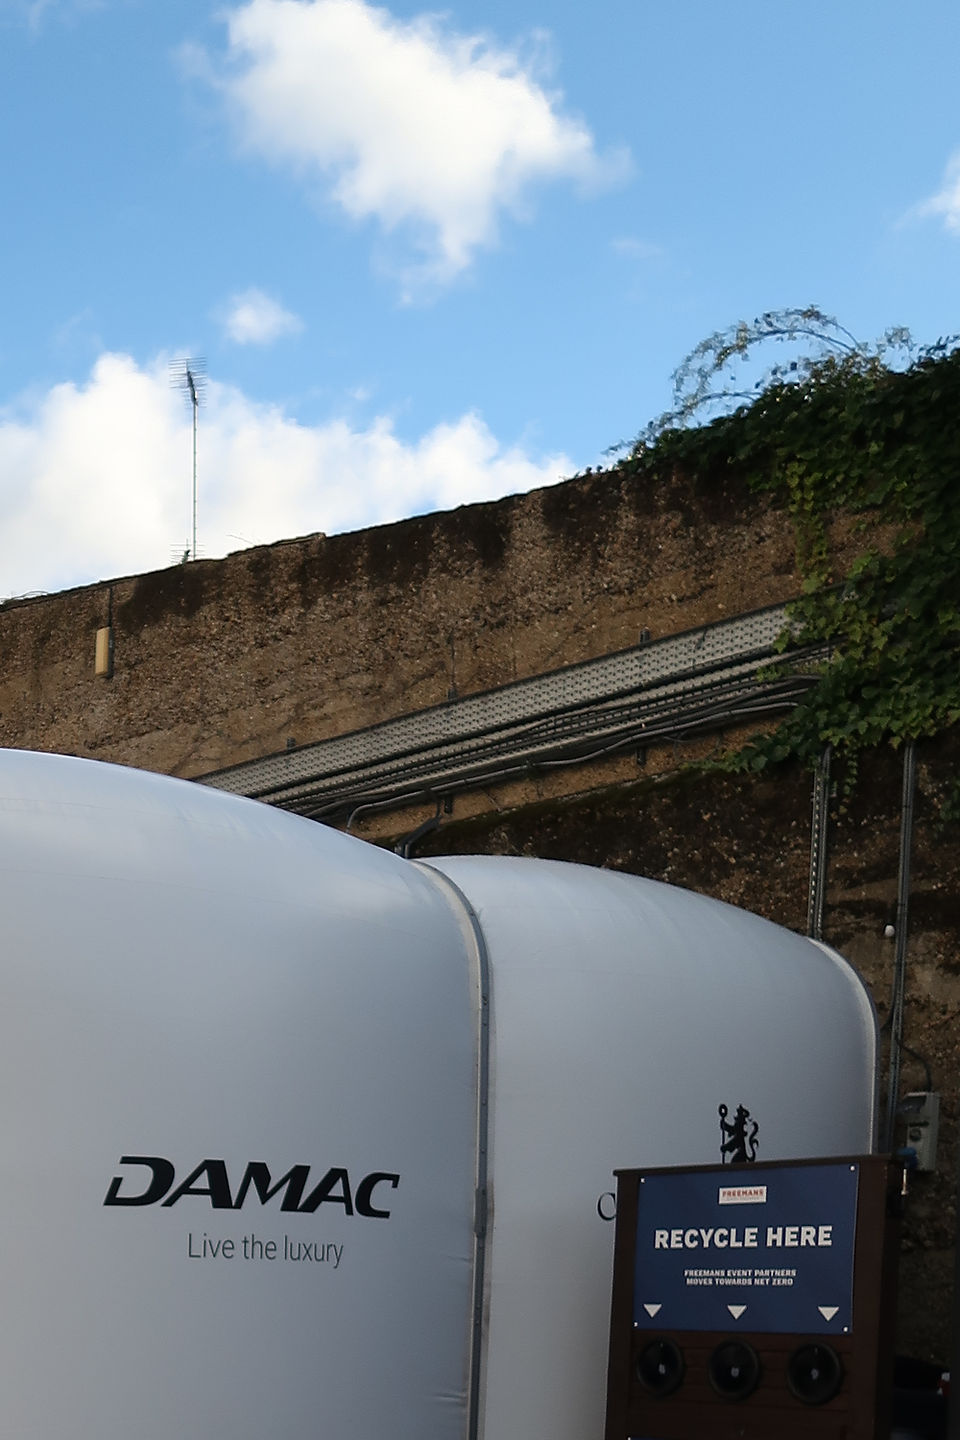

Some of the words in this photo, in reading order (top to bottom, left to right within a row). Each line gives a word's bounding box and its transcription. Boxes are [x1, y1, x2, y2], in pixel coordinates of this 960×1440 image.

[102, 1155, 401, 1219] DAMAC
[722, 1188, 765, 1198] FREEMANS
[653, 1226, 759, 1250] RECYCLE
[765, 1225, 833, 1249] HERE
[187, 1232, 236, 1260] Live
[240, 1233, 278, 1260] the
[283, 1235, 345, 1270] luxury
[683, 1269, 726, 1278] FREEMANS
[727, 1269, 753, 1277] EVENT
[754, 1269, 798, 1277] PARTNERS
[686, 1278, 713, 1287] MOVES
[715, 1278, 753, 1287] TOWARDS
[754, 1277, 770, 1286] NET
[772, 1277, 795, 1286] ZERO
